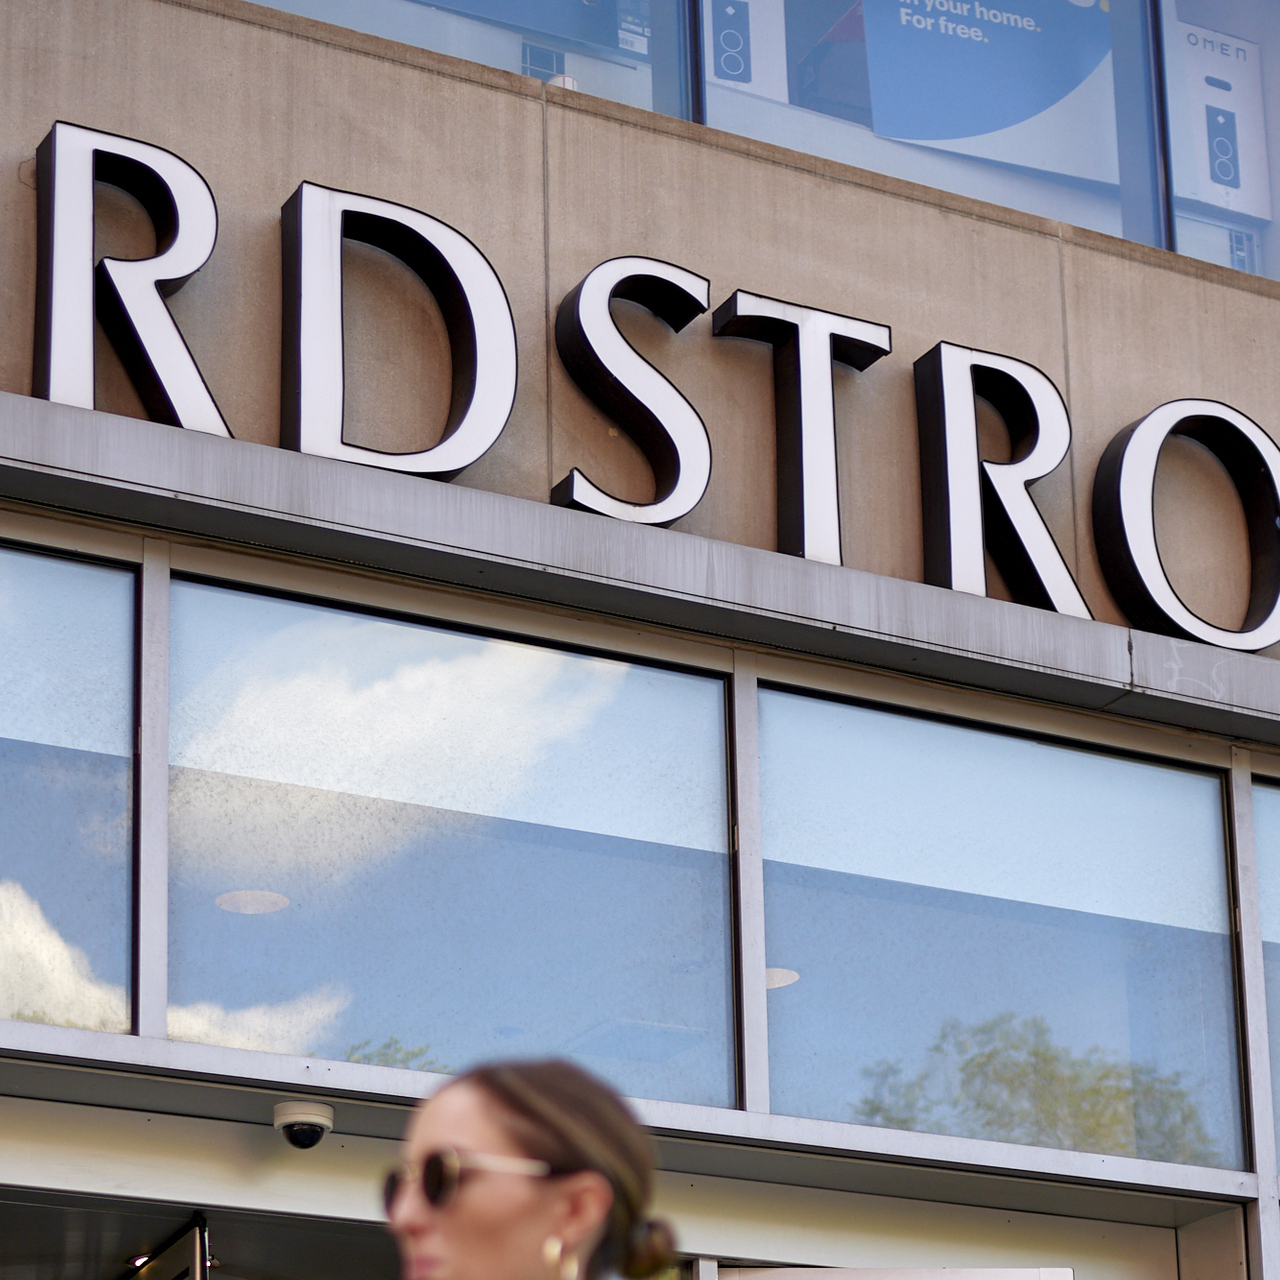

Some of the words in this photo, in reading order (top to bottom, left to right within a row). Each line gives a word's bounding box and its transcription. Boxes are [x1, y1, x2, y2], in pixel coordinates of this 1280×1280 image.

[899, 7, 934, 31] For
[938, 16, 989, 43] free.
[974, 1, 1041, 32] home.
[1186, 32, 1247, 62] OMEN
